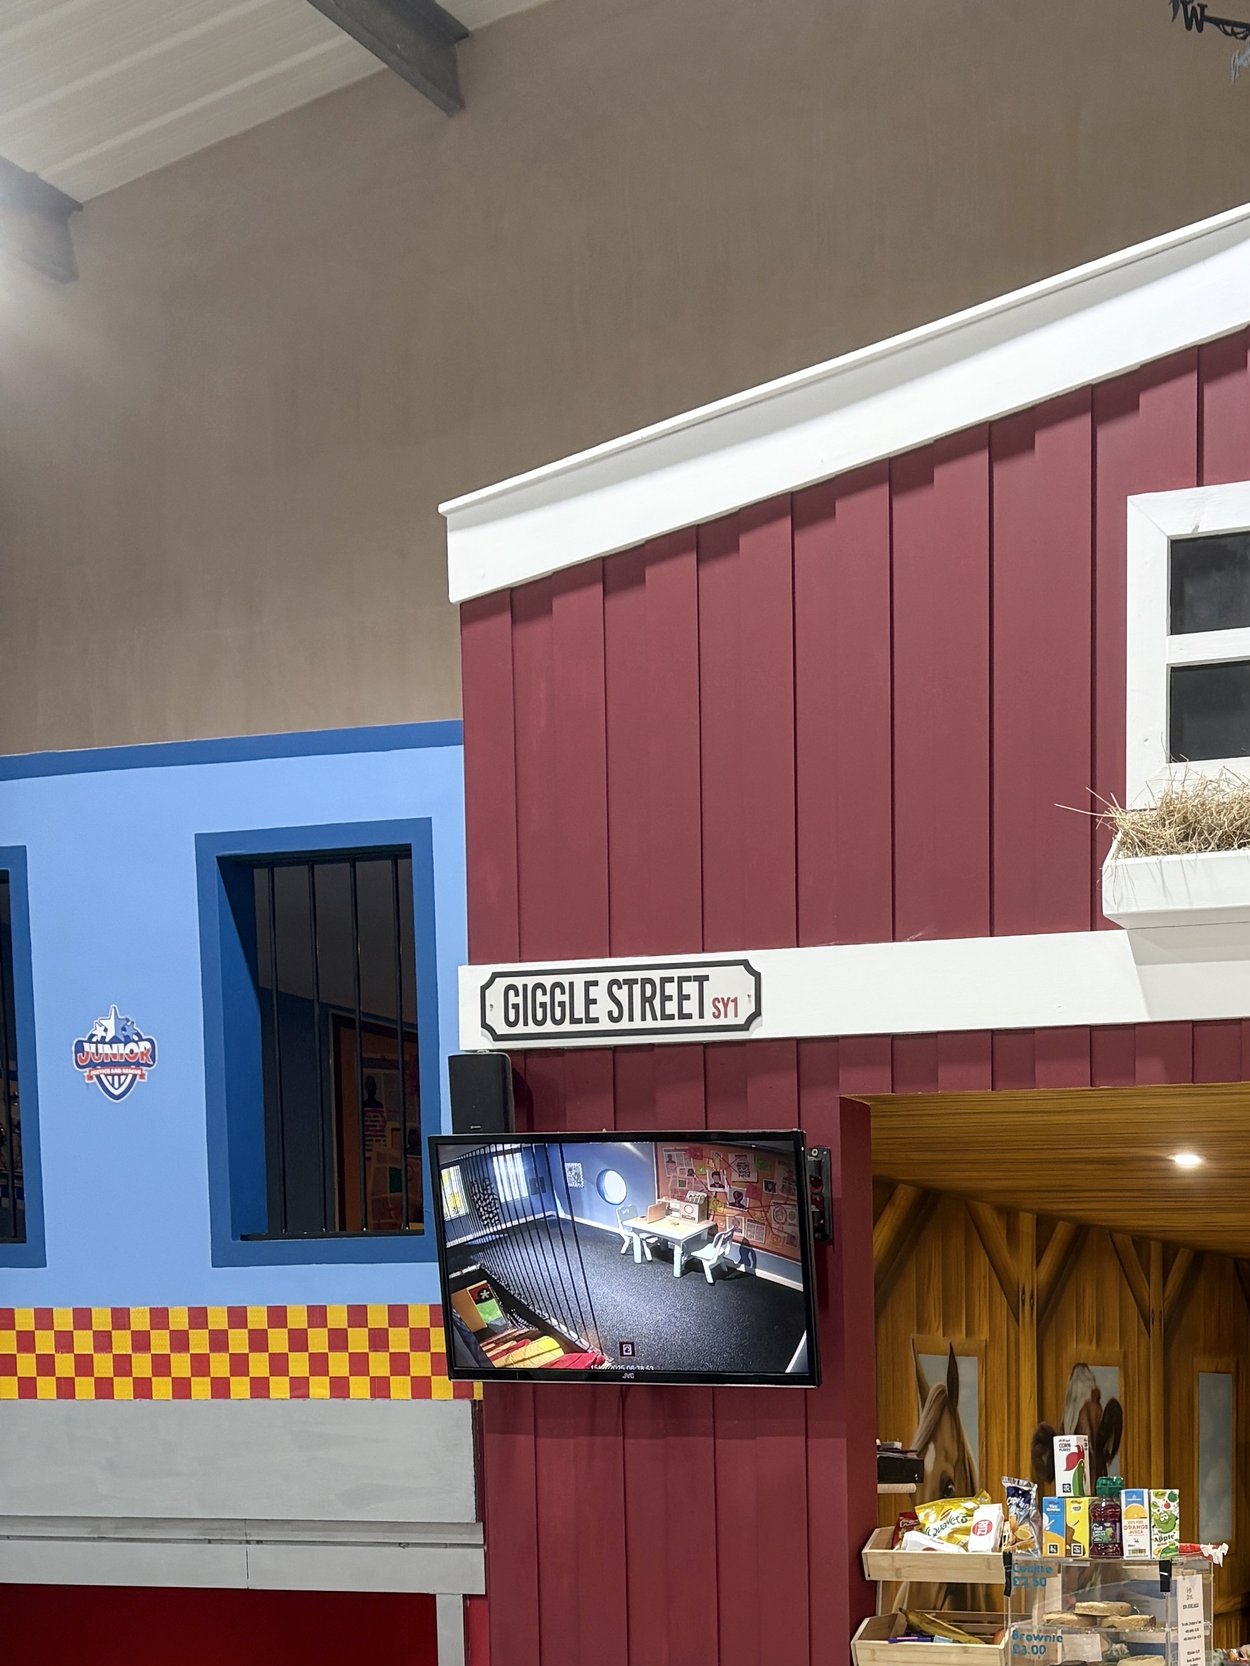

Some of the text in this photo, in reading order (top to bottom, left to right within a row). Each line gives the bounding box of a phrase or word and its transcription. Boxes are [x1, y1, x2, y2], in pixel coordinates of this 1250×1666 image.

[503, 974, 739, 1028] GIGGLE STREET SY1
[77, 1041, 153, 1066] JUNIOR
